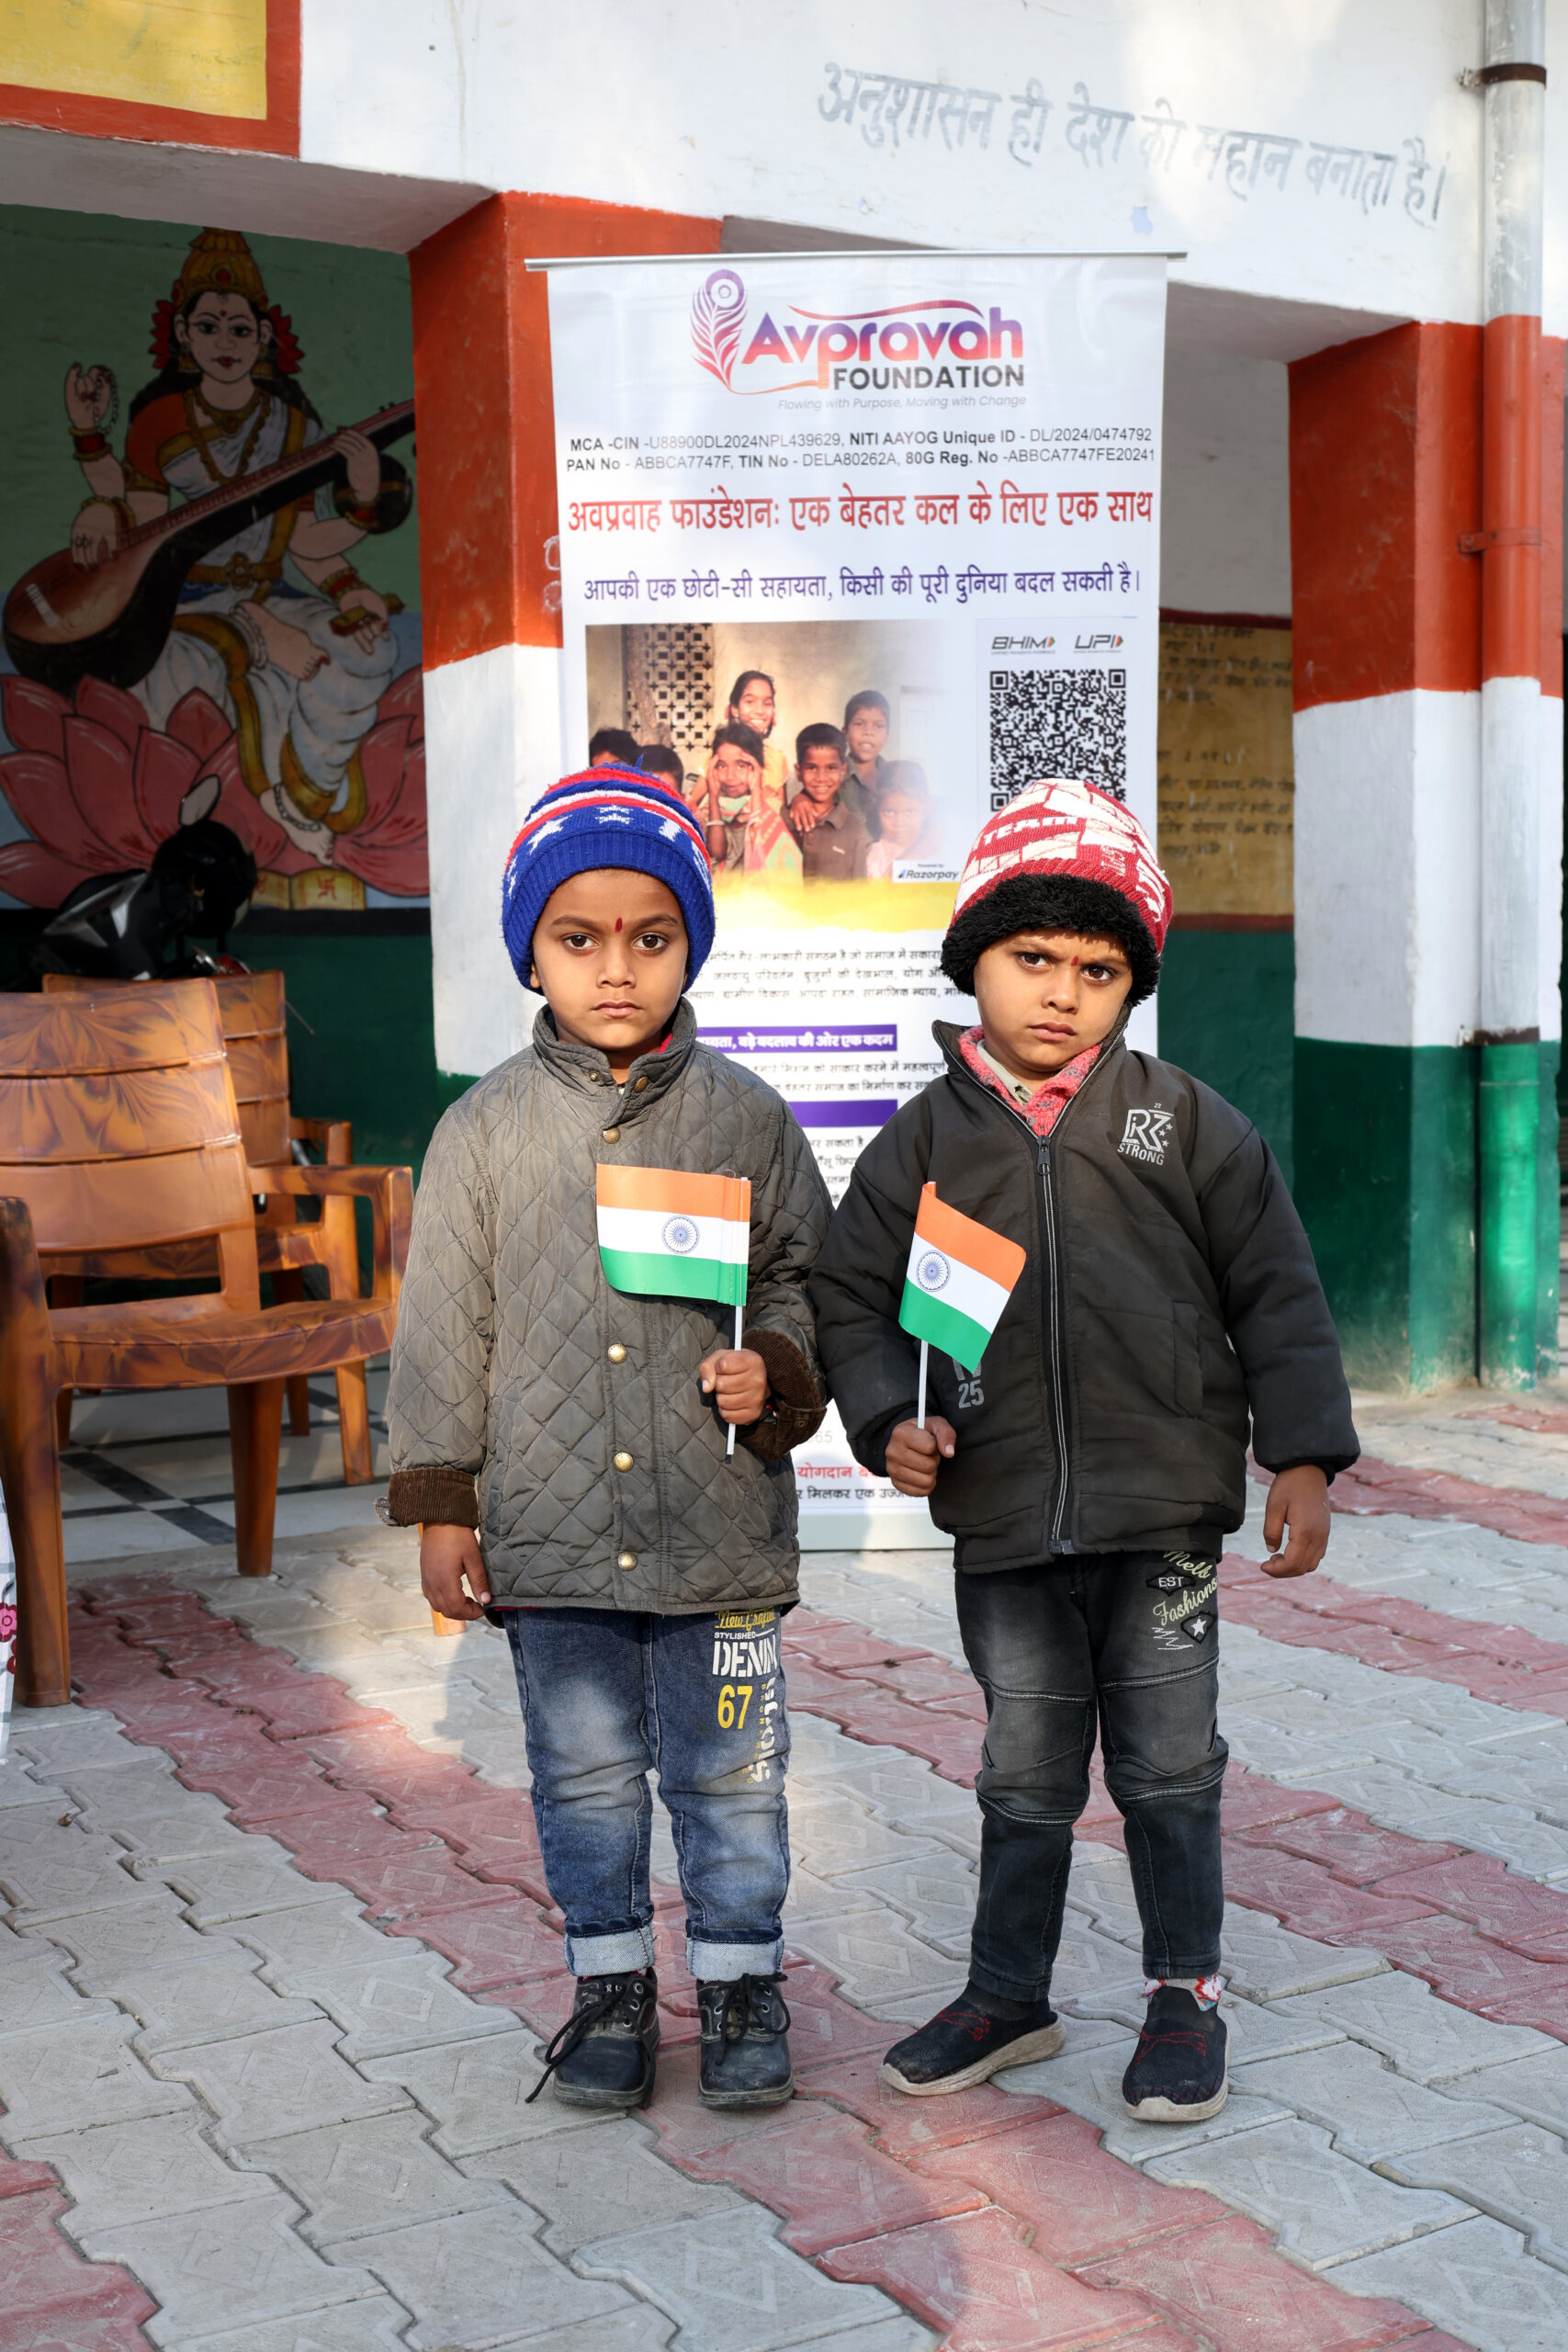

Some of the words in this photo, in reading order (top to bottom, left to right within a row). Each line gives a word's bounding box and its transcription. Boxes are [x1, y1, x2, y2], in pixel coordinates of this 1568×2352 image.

[818, 62, 1002, 151] अनुशासन
[1009, 77, 1054, 167] ही
[1066, 81, 1135, 168] देश
[1139, 96, 1187, 173] को
[1192, 123, 1303, 202] महान
[1305, 141, 1398, 215] बनाता
[741, 306, 1023, 390] Avpravah
[833, 365, 1024, 390] FOUNDATION
[778, 399, 822, 413] Flowing
[826, 398, 850, 410] with
[852, 397, 903, 412] Purpose,
[906, 396, 948, 410] Moving
[952, 395, 976, 407] with
[980, 395, 1027, 410] Change
[570, 437, 604, 452] MCA
[850, 432, 879, 447] NITI
[883, 431, 939, 446] AAYOG
[942, 430, 997, 447] Unique
[1000, 429, 1016, 443] ID
[1030, 427, 1153, 442] DL/2024/0474792
[567, 458, 596, 472] PAN
[600, 458, 621, 470] No
[634, 456, 735, 471] ABBCA7747F,
[738, 455, 763, 469] TIN
[768, 454, 789, 468] No
[803, 451, 901, 469] DELA80262A,
[906, 451, 935, 466] 80G
[940, 450, 974, 467] Reg.
[977, 449, 998, 465] No
[568, 500, 662, 533] अवप्रवाह
[788, 496, 831, 531] एक
[838, 482, 907, 529] बेहतर
[913, 494, 960, 526] कल
[966, 480, 992, 525] के
[999, 479, 1049, 526] लिए
[1055, 492, 1100, 526] एक
[1106, 492, 1154, 522] साथ
[583, 571, 640, 600] आपकी
[646, 578, 677, 601] एक
[682, 569, 753, 599] छोटी-सी
[759, 575, 833, 601] सहायता,
[840, 566, 885, 596] किसी
[889, 565, 913, 595] की
[919, 565, 949, 604] पूरी
[955, 564, 1008, 604] दुनिया
[1013, 571, 1055, 594] बदल
[1061, 561, 1114, 593] सकती
[991, 636, 1048, 650] BHIM
[1074, 634, 1116, 650] UPI
[983, 817, 1077, 846] TEAM
[906, 869, 959, 880] Razorpay
[865, 951, 894, 960] समाज
[909, 950, 942, 960] सकारा
[903, 966, 923, 978] योग
[863, 985, 908, 998] सामाजिक
[758, 1035, 796, 1047] बदलाव
[797, 1031, 814, 1047] की
[840, 1035, 862, 1048] एक
[863, 1034, 894, 1046] कदम
[1117, 1142, 1165, 1166] STRONG
[958, 1379, 985, 1409] 25
[796, 1462, 852, 1479] योगदान
[807, 1486, 851, 1499] मिलकर
[855, 1488, 875, 1499] एक
[1158, 1577, 1184, 1588] EST
[715, 1632, 756, 1640] STYLISHED
[717, 1684, 753, 1730] 67
